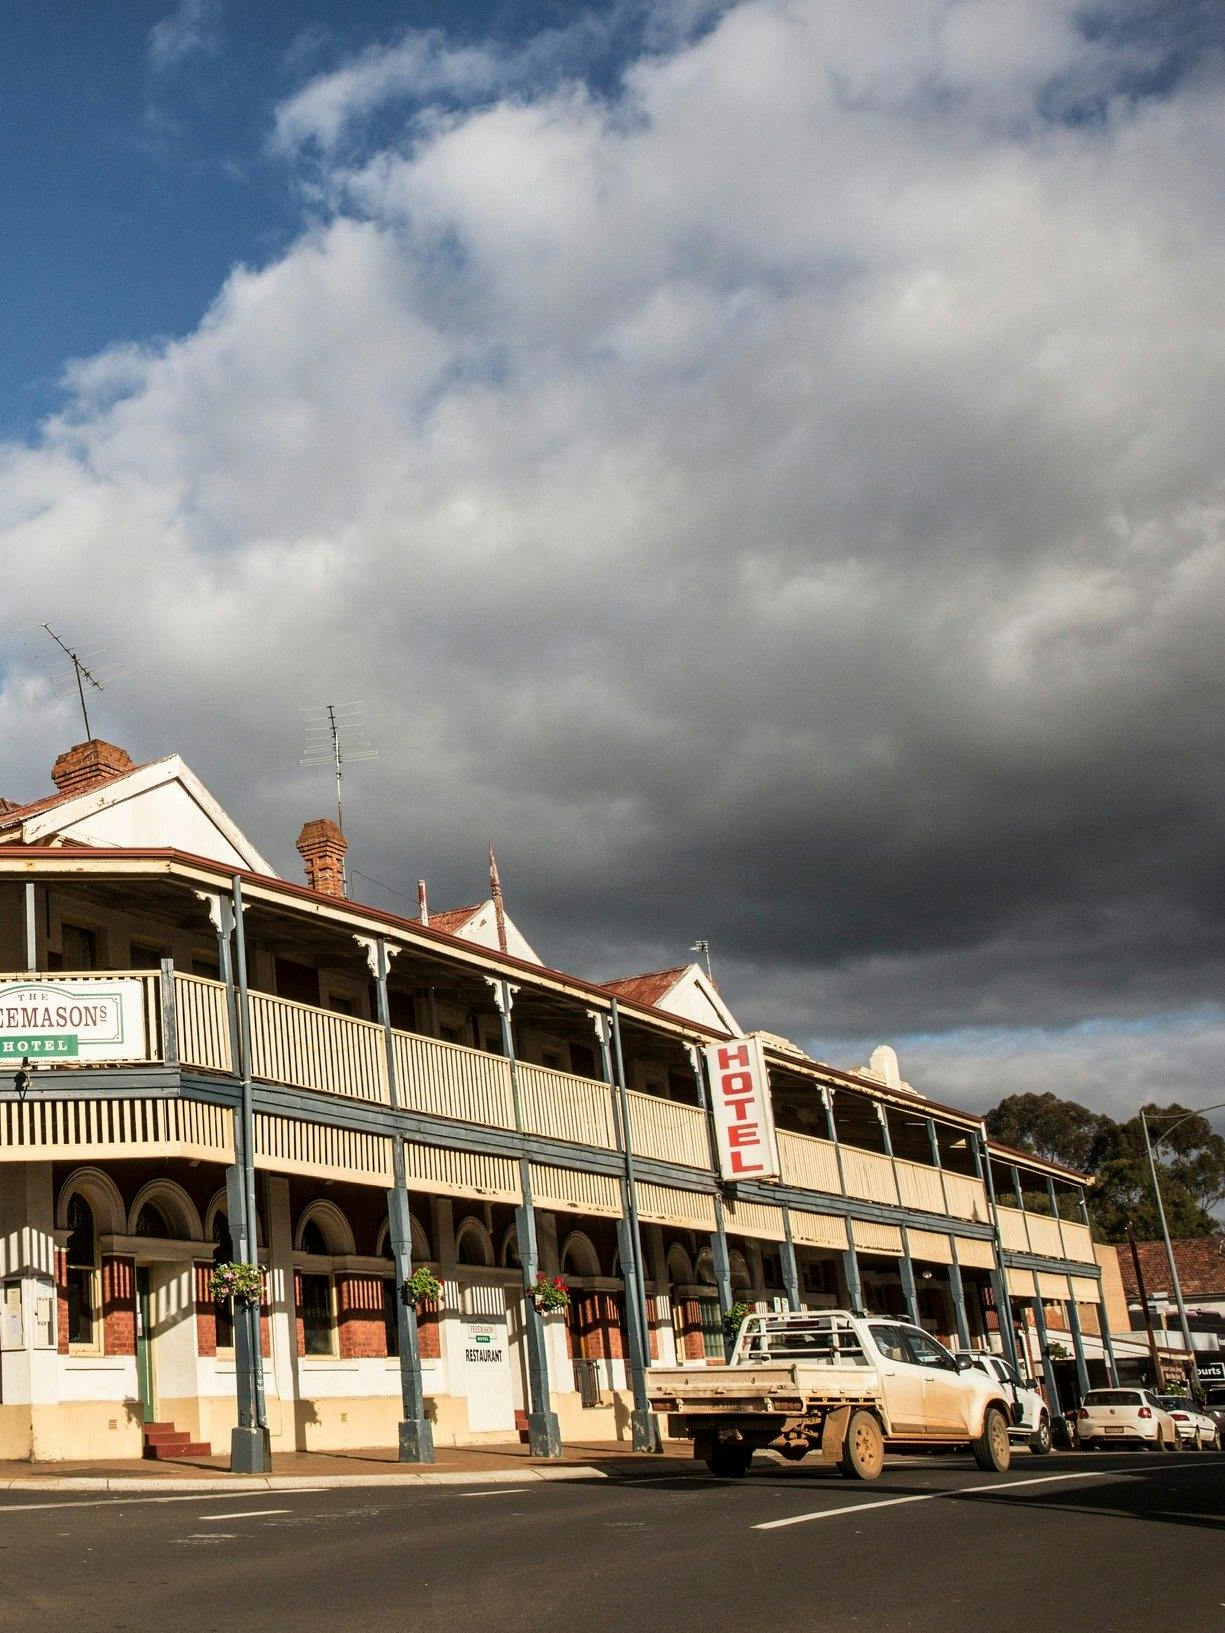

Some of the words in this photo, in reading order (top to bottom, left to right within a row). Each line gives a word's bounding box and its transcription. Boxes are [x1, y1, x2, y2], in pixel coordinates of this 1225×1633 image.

[2, 1040, 68, 1053] HOTEL
[717, 1044, 764, 1174] HOTEL
[466, 1349, 502, 1362] RESTAURANT
[1197, 1367, 1221, 1376] ourts
